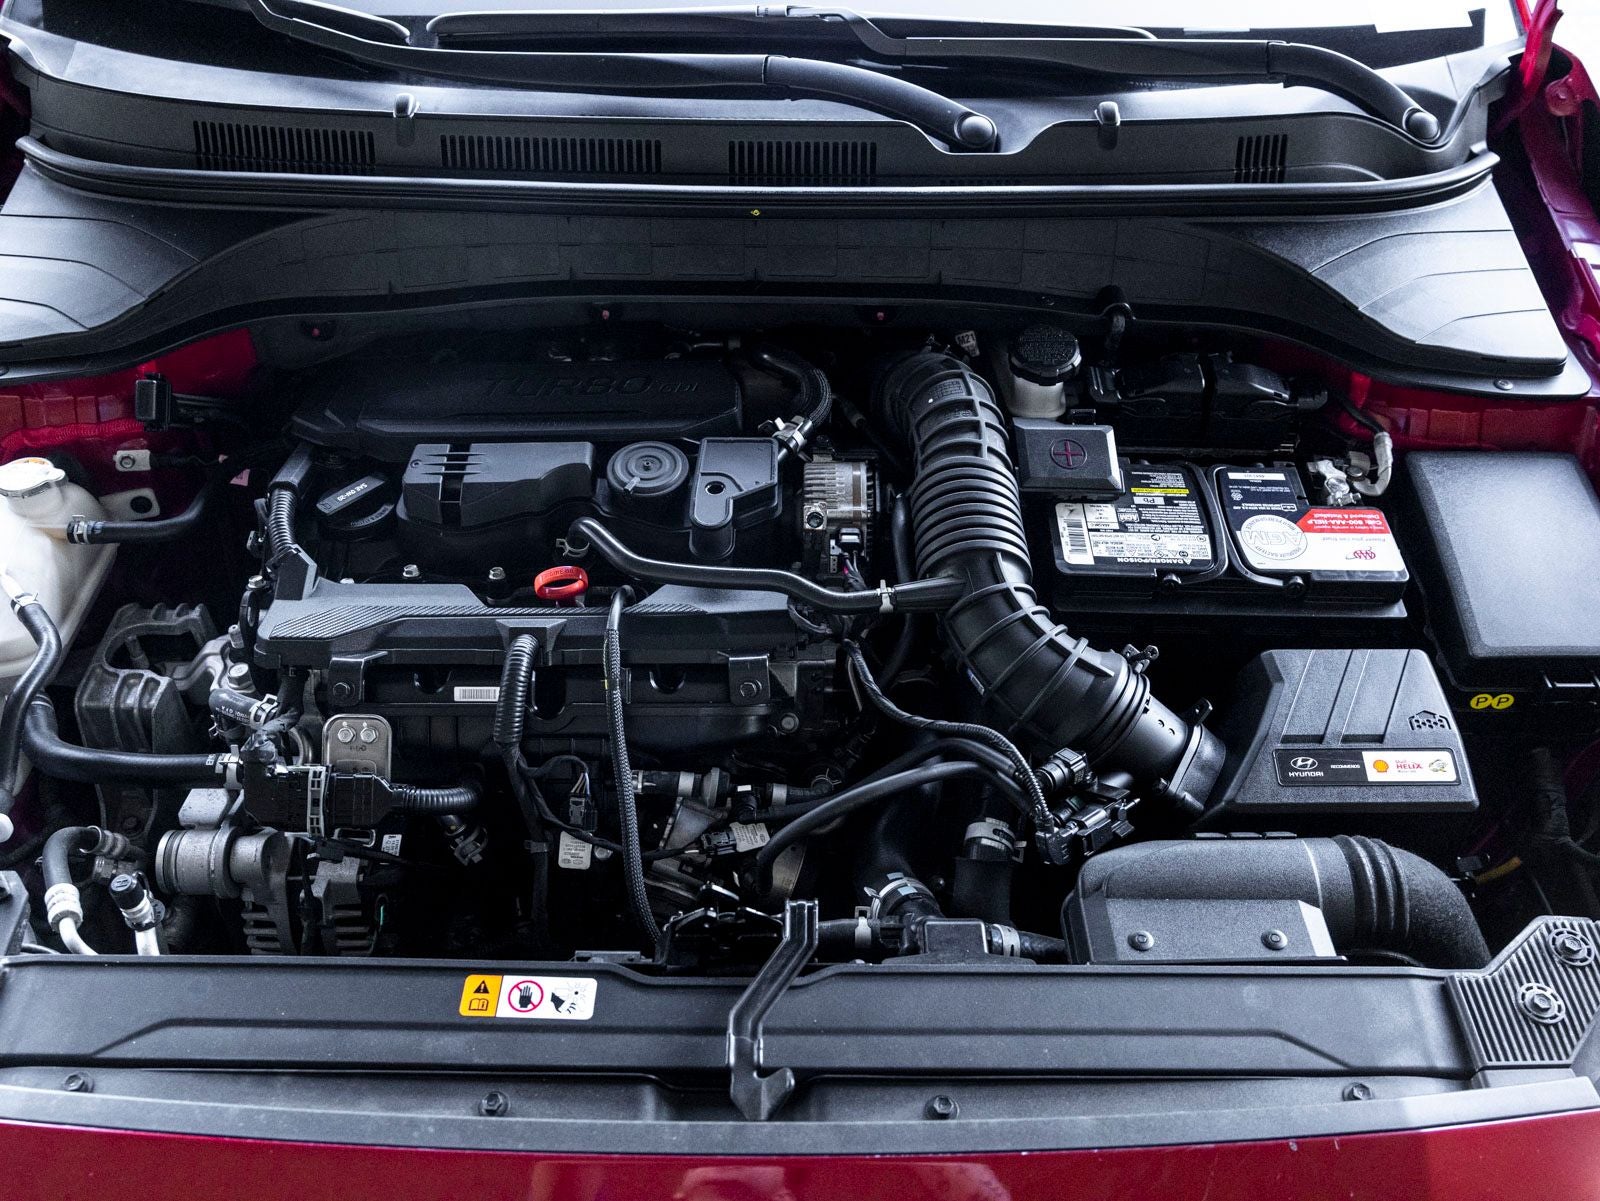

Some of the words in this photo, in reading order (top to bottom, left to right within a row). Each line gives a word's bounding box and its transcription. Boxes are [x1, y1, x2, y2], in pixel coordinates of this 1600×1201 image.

[959, 333, 975, 345] M21
[484, 374, 655, 397] TURBO
[354, 482, 367, 491] SAE
[337, 489, 355, 501] 0W-20
[1243, 530, 1303, 546] AGM
[1254, 546, 1278, 557] BATTERY
[1353, 550, 1376, 560] AAA
